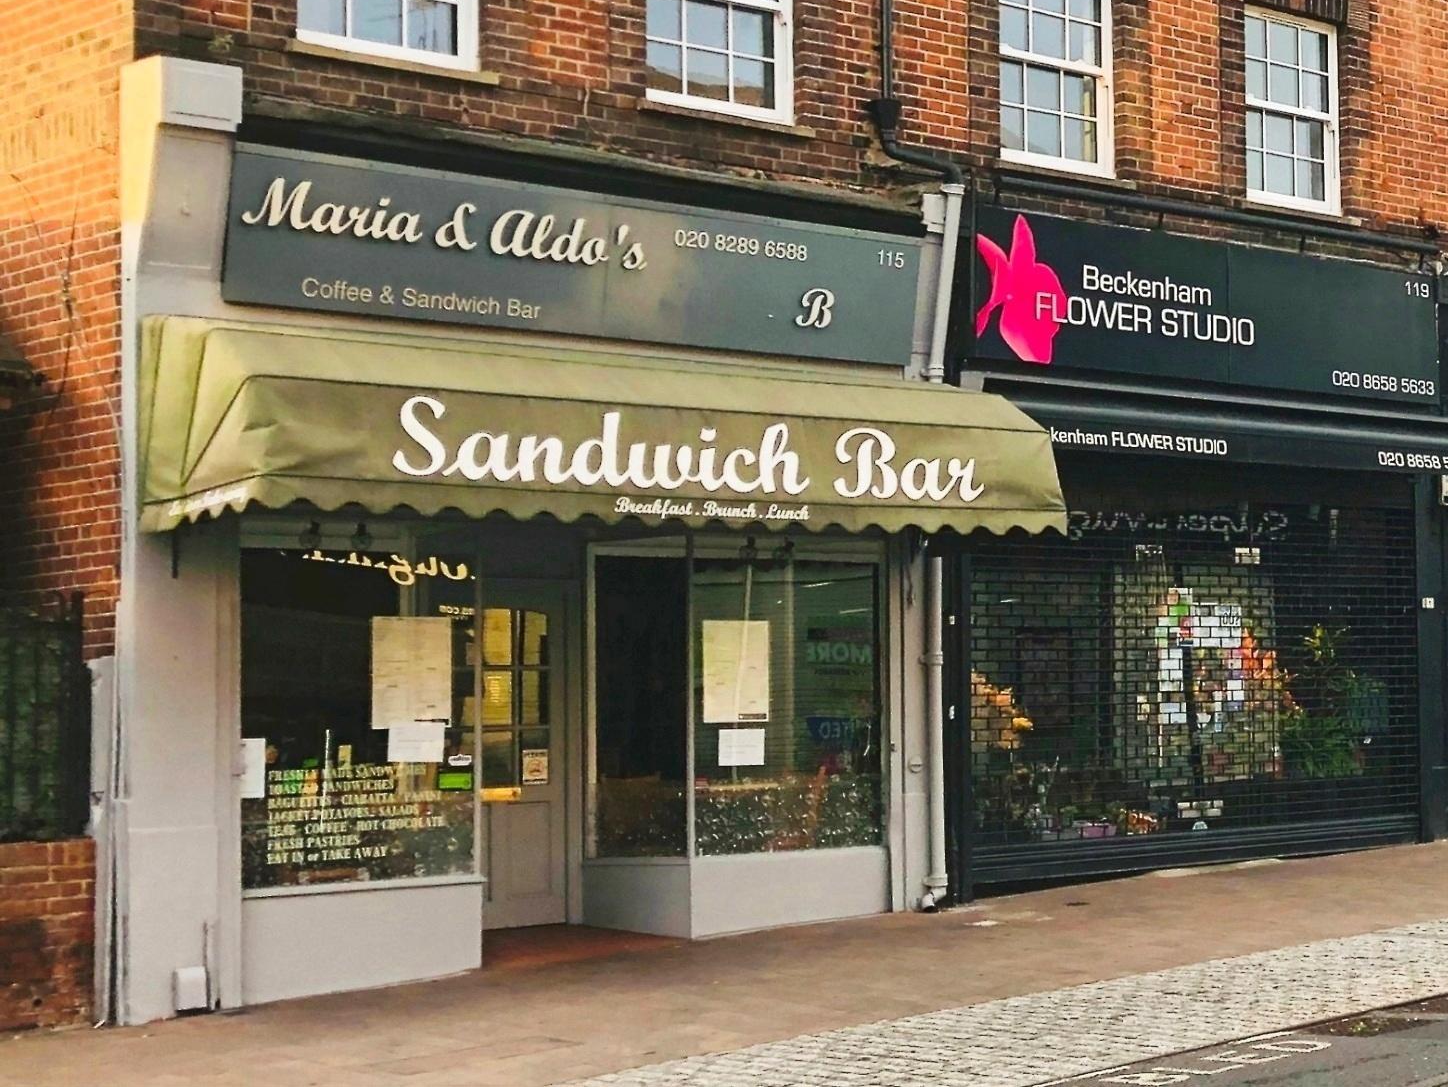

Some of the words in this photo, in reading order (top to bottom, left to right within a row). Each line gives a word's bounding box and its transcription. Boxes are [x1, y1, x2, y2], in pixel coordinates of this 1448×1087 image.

[241, 177, 423, 247] Maria
[435, 201, 477, 251] &
[490, 209, 648, 272] Aldo's
[674, 229, 709, 250] 020
[714, 233, 760, 256] 8289
[763, 238, 808, 263] 6588
[877, 249, 905, 269] 115
[301, 277, 375, 306] Coffee
[379, 284, 396, 305] &
[401, 286, 501, 316] Sandwich
[506, 298, 542, 320] Bar
[1082, 264, 1213, 306] Beckenham
[1404, 280, 1430, 298] 119
[1035, 291, 1152, 335] FLOWER
[1161, 310, 1255, 347] STUDIO
[1332, 369, 1359, 388] 020
[1363, 373, 1397, 392] 8658
[1400, 377, 1435, 396] 5633
[392, 395, 810, 495] Sandwich
[834, 427, 985, 502] Bar
[1050, 427, 1108, 446] kenham
[1112, 431, 1173, 450] FLOWER
[1176, 436, 1228, 455] STUDIO
[1377, 451, 1403, 468] 020
[1407, 453, 1441, 470] 8658
[614, 495, 693, 519] Breakfast
[702, 499, 756, 520] Brunch
[765, 503, 810, 521] Lunch
[267, 852, 290, 865] EAT
[322, 849, 351, 861] TAKE
[354, 846, 388, 859] AWAY
